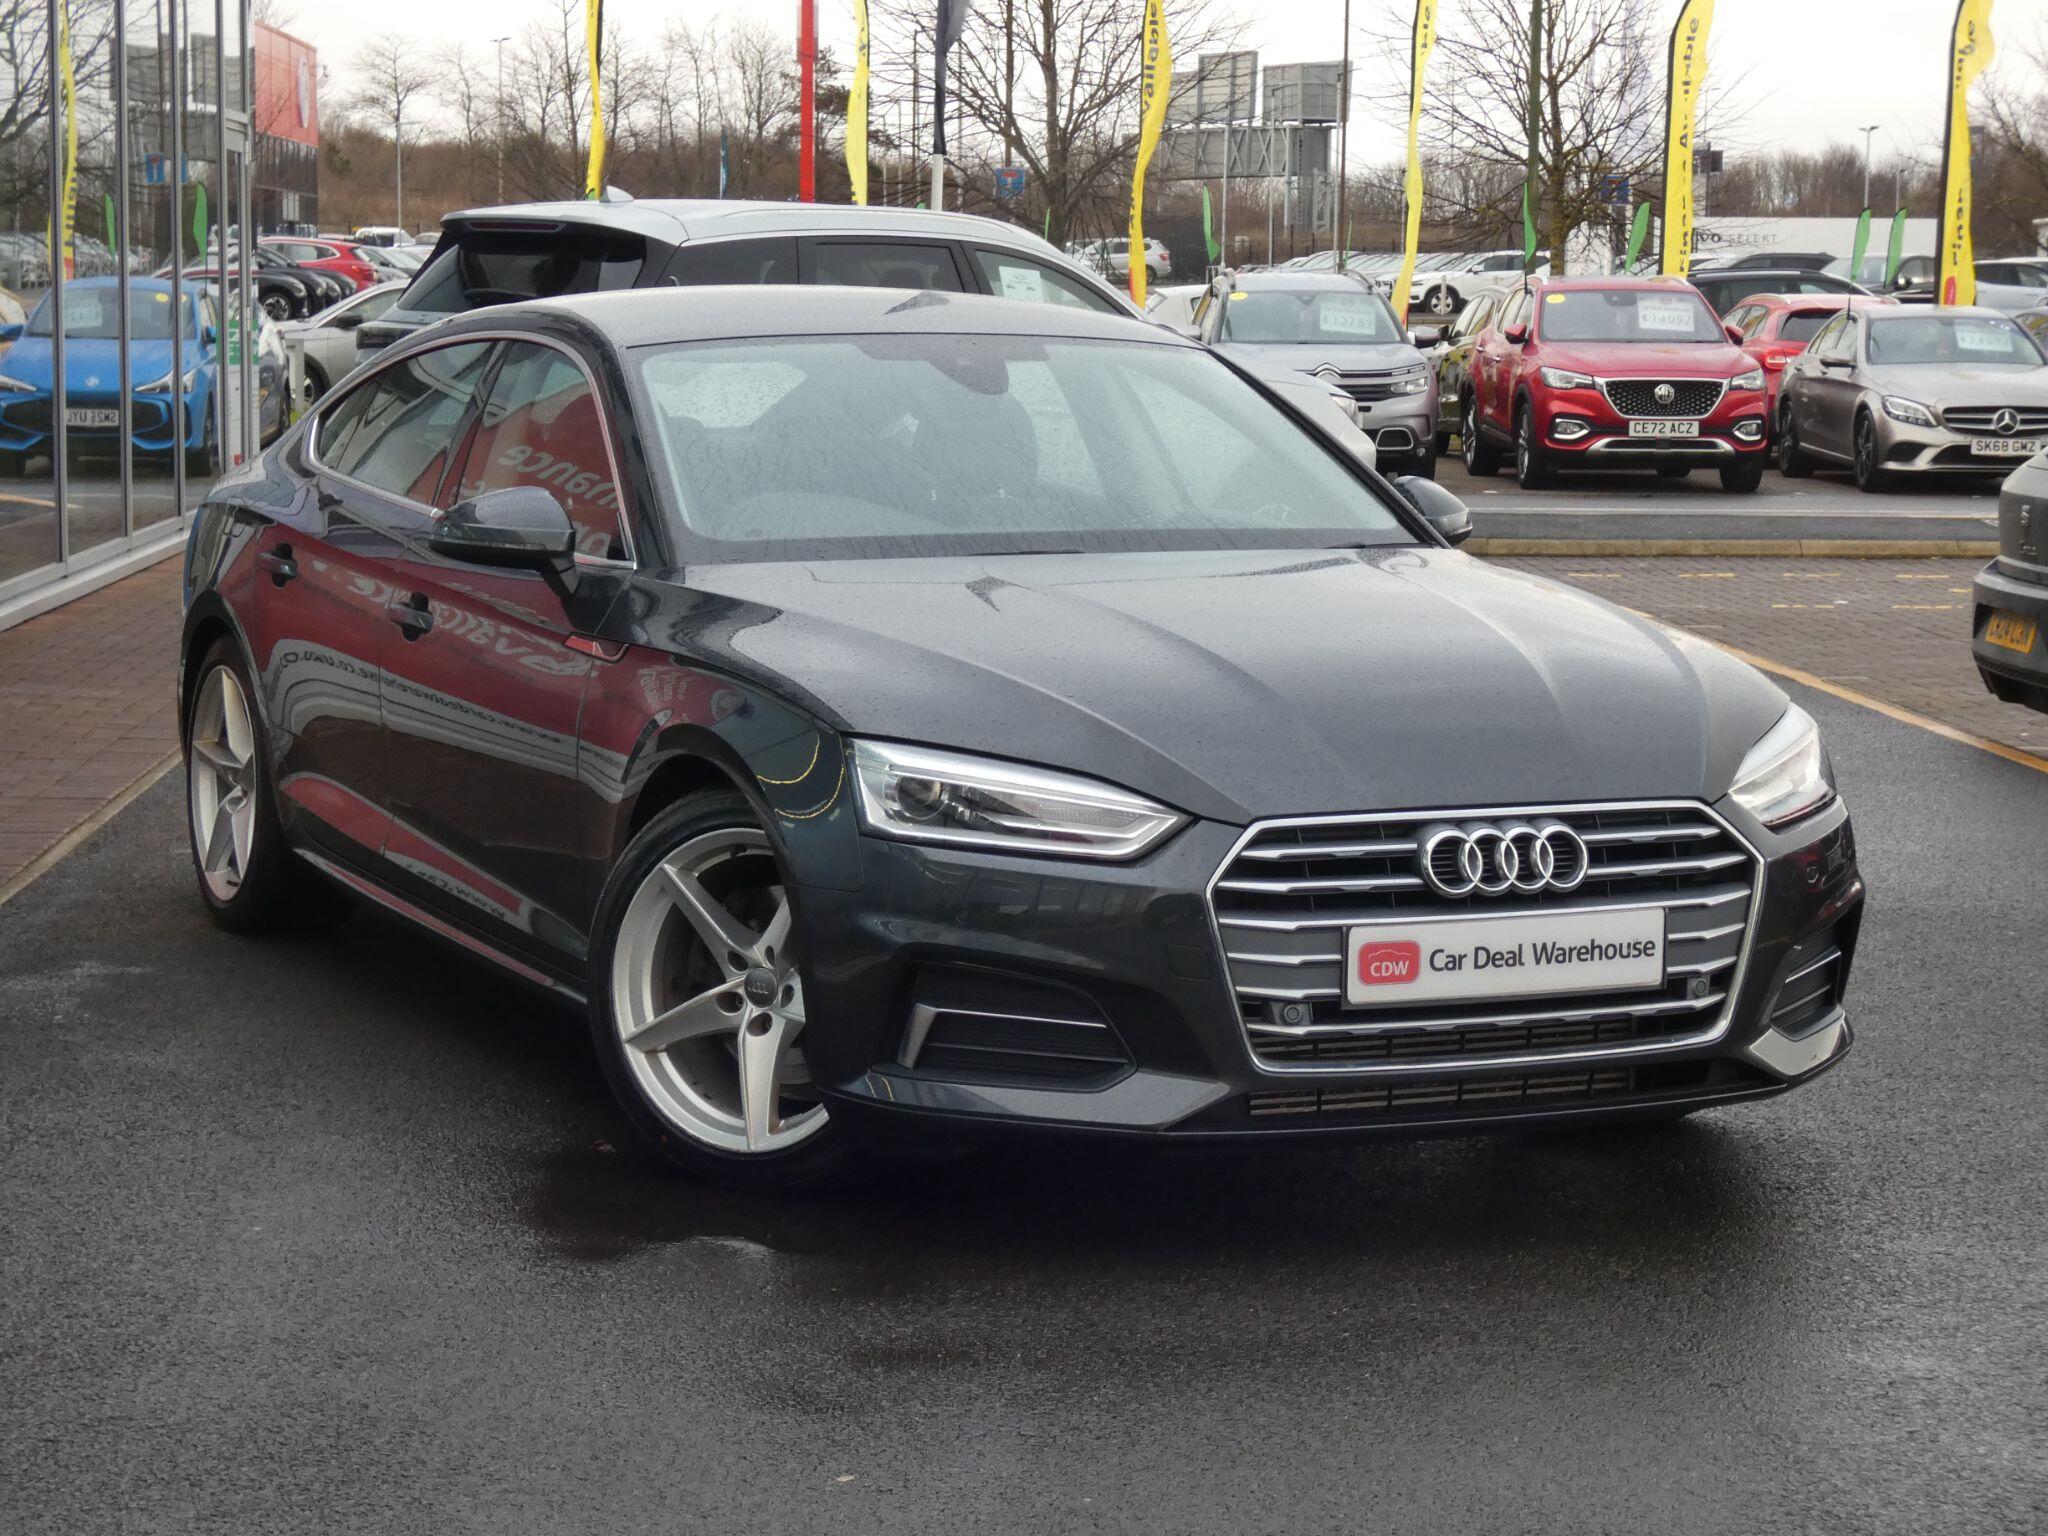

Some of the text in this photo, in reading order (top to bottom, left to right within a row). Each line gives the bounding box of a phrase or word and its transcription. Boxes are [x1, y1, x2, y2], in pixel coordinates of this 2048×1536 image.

[1728, 233, 1778, 245] SELEKT
[1633, 422, 1694, 434] CE72 ACZ
[1976, 440, 2036, 452] SK68 GMZ
[1429, 938, 1656, 972] Car Deal Warehouse
[1370, 960, 1409, 977] CDW
